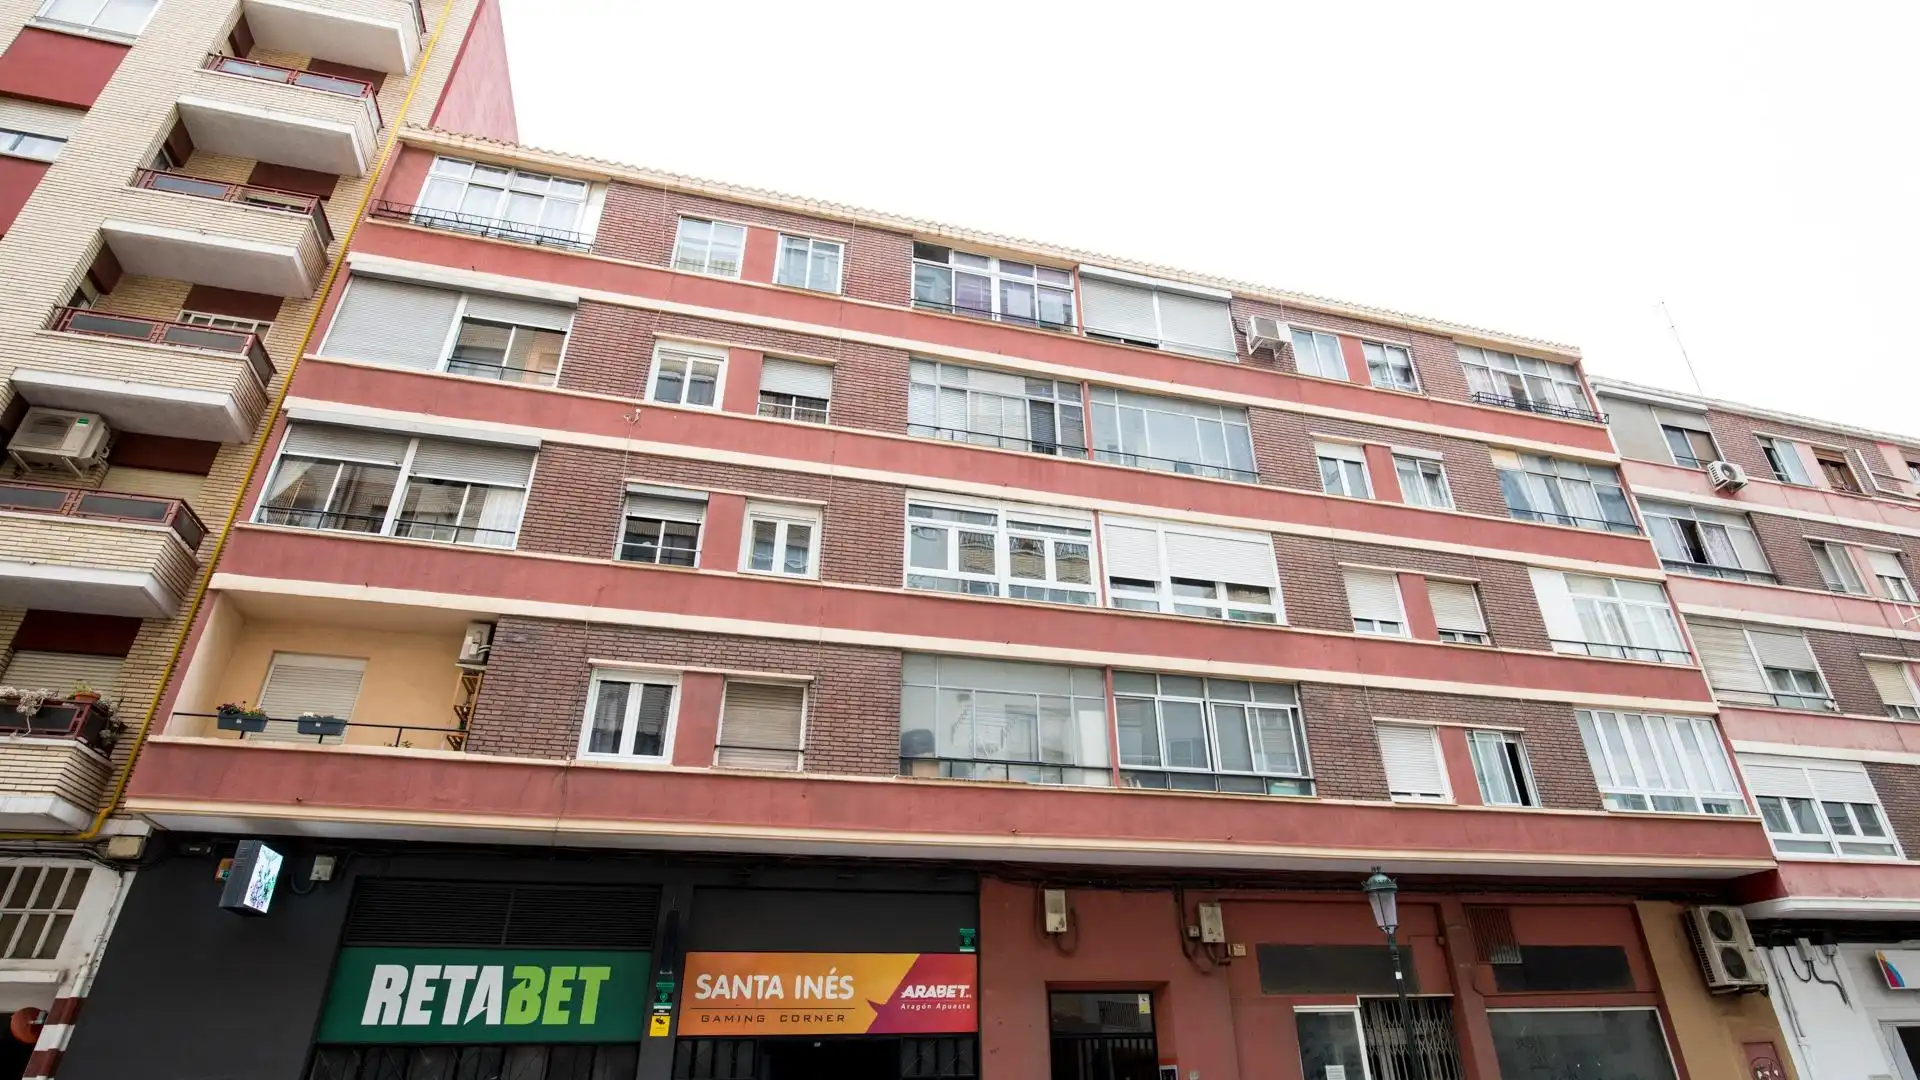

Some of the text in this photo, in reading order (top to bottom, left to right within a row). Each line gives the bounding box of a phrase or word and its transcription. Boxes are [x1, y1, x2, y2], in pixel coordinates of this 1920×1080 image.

[695, 966, 855, 1000] SANTA INÉS
[361, 964, 611, 1026] RETABET
[701, 1013, 846, 1023] GAMING CORNER
[900, 1003, 971, 1011] Aragón Apuesta
